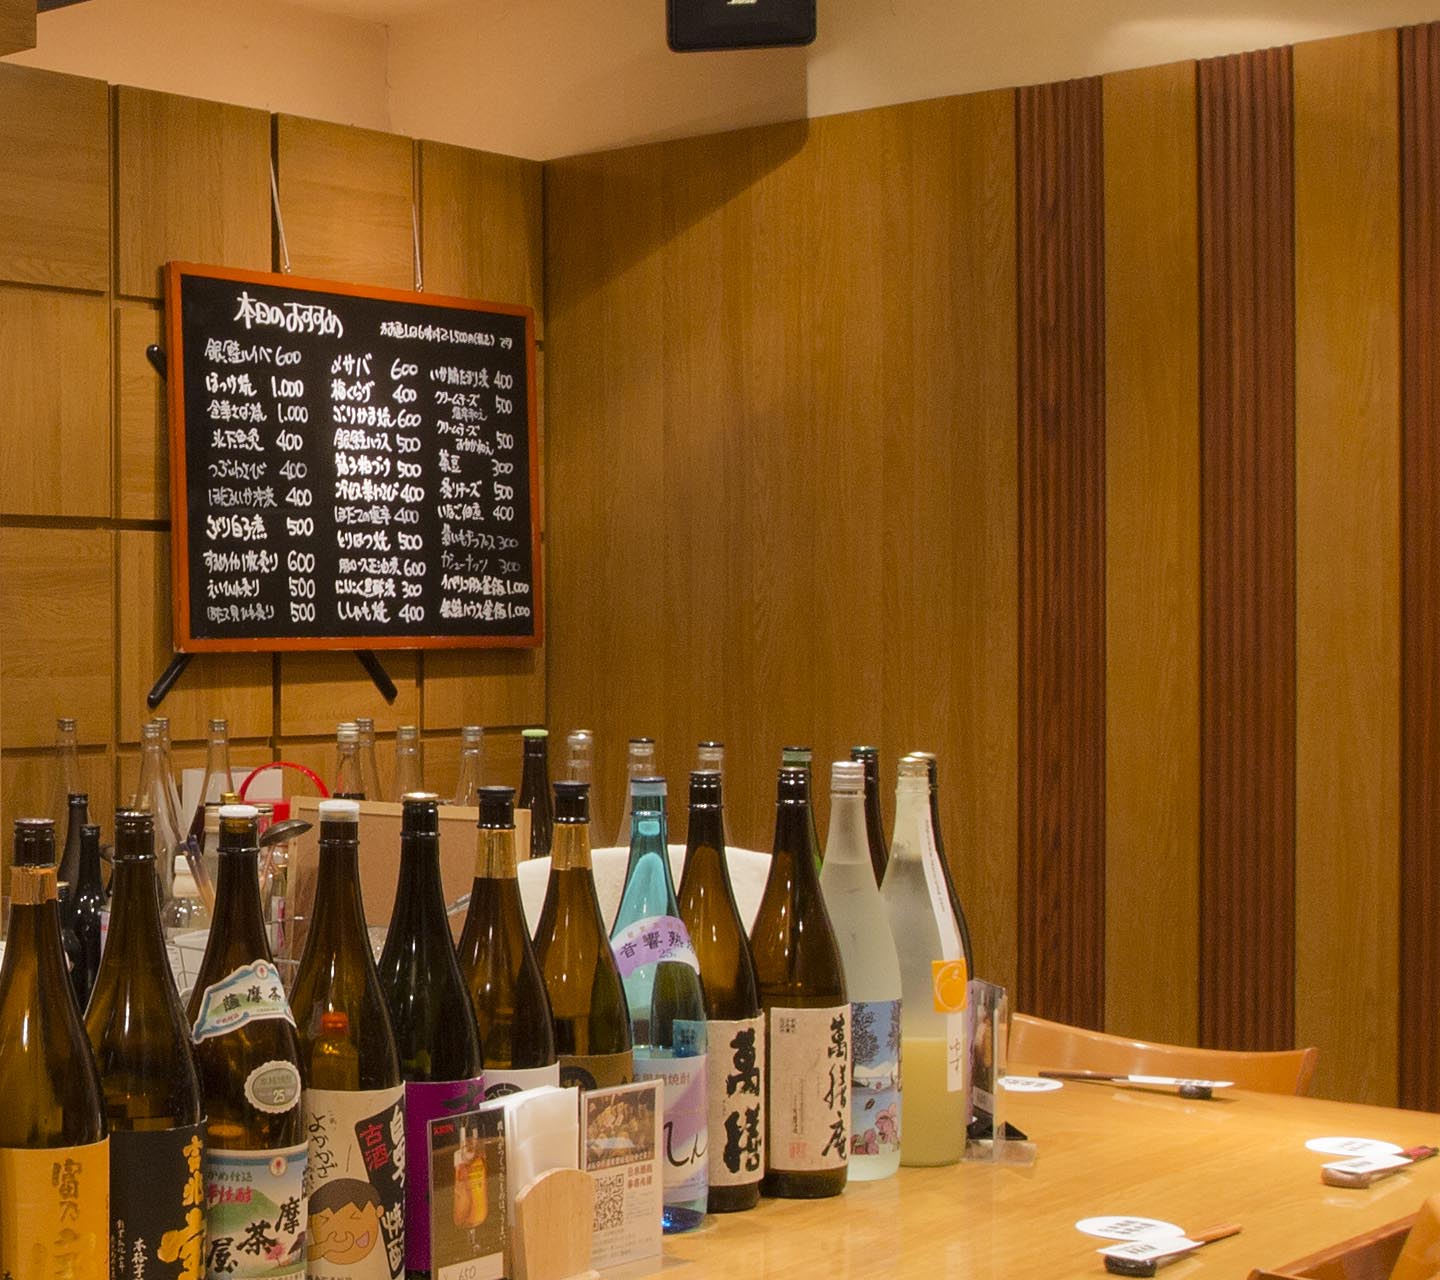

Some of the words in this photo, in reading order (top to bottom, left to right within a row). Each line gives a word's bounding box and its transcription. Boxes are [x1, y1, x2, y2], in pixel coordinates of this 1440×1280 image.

[234, 291, 344, 338] 本日のおすすめ
[275, 346, 302, 366] 600
[391, 358, 418, 380] 600
[205, 372, 257, 396] ほっけ焼
[494, 371, 513, 389] 400
[331, 379, 375, 402] 梅くらげ
[392, 384, 417, 403] 400
[495, 395, 512, 414] 500
[397, 409, 421, 428] 600
[276, 429, 303, 452] 400
[396, 434, 420, 453] 500
[497, 431, 513, 450] 500
[279, 460, 307, 480] 400
[397, 461, 422, 478] 500
[491, 459, 513, 477] 300
[285, 487, 312, 507] 400
[400, 484, 424, 503] 400
[494, 481, 513, 500] 500
[394, 511, 419, 524] 400
[493, 506, 514, 521] 400
[286, 517, 314, 536] 500
[398, 531, 423, 550] 500
[498, 536, 519, 550] 300
[287, 550, 315, 573] 600
[404, 559, 426, 576] 600
[498, 563, 520, 574] 300
[289, 577, 315, 598] 500
[401, 581, 422, 598] 300
[290, 602, 315, 622] 500
[399, 604, 424, 623] 400
[273, 1088, 289, 1105] 25
[360, 1123, 389, 1171] 古酒
